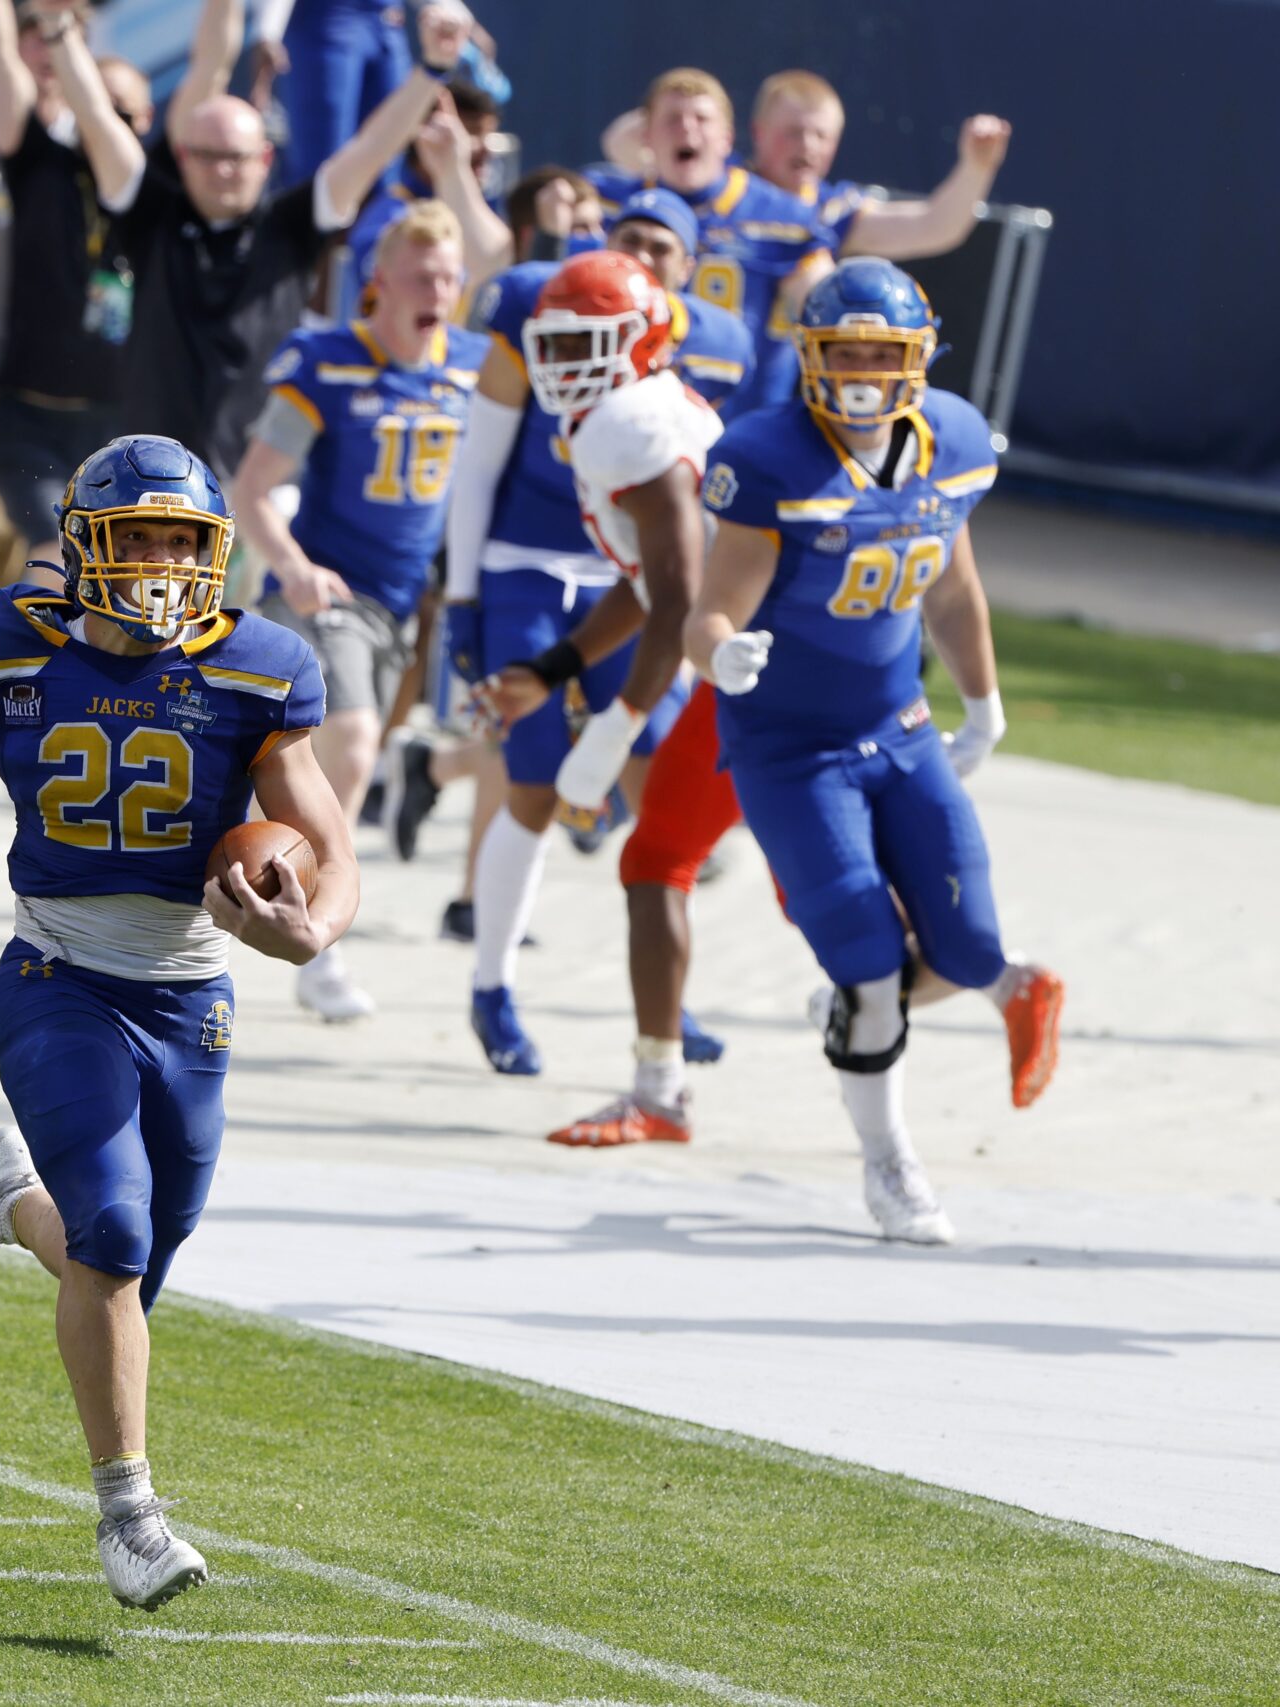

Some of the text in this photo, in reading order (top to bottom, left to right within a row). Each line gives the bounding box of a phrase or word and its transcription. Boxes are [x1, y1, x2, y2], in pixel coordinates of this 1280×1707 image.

[150, 495, 184, 506] STATE
[3, 695, 42, 717] VALLEY
[86, 697, 156, 719] JACKS
[170, 707, 213, 722] CHAMPIONSHIP
[36, 722, 194, 852] 22
